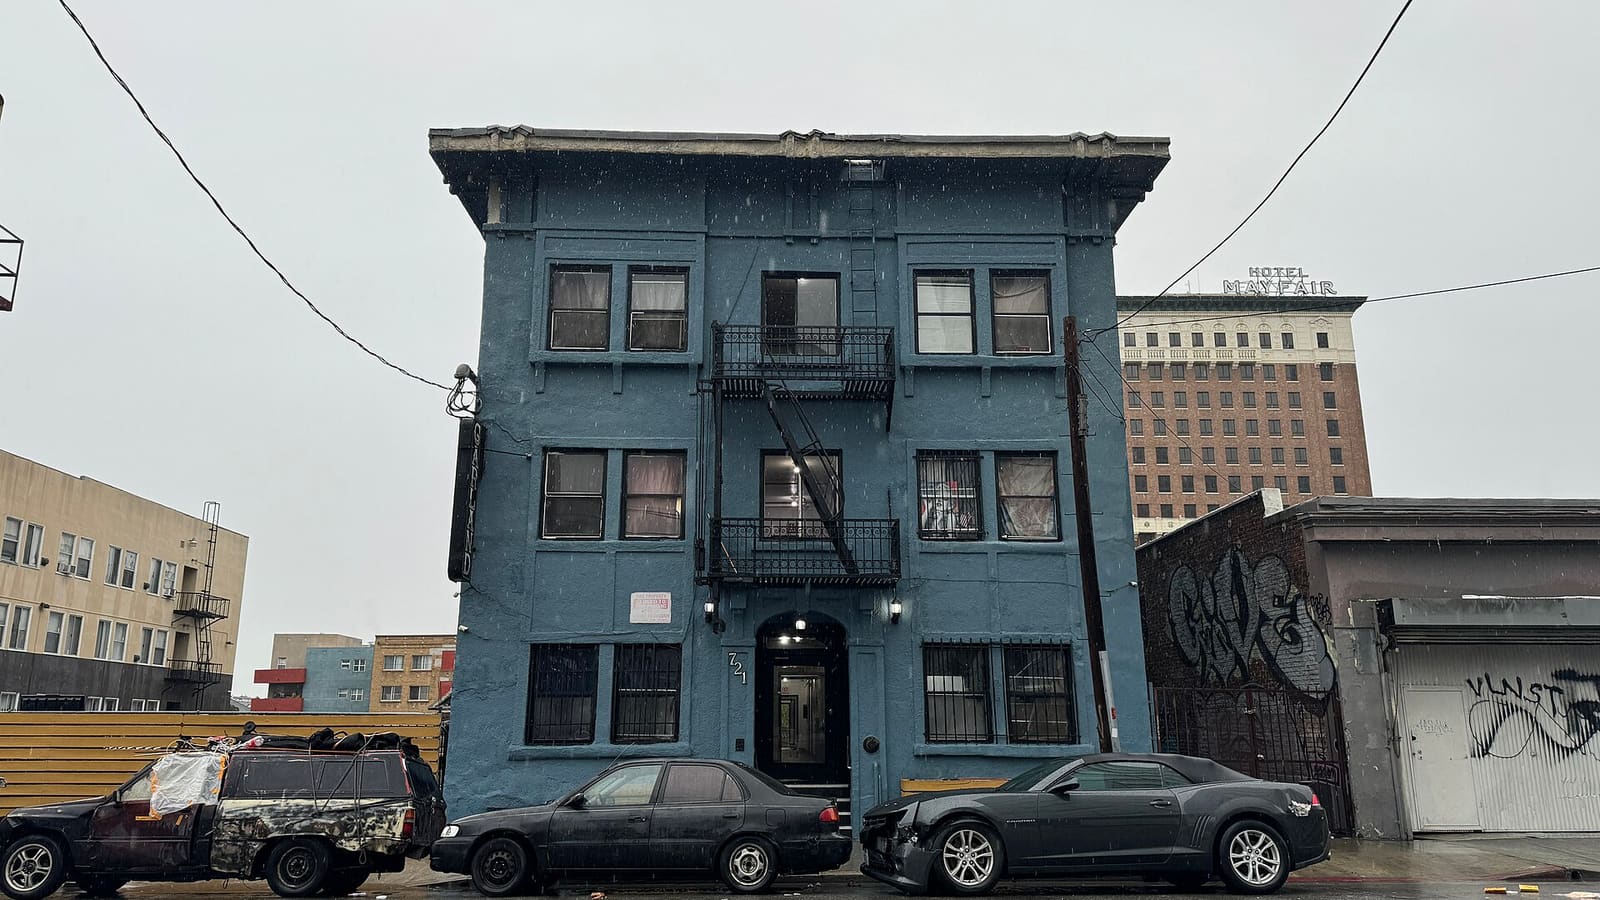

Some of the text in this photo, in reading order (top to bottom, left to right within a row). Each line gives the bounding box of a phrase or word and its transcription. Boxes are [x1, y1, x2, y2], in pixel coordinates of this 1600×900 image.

[1248, 267, 1309, 278] HOTEL
[1222, 280, 1338, 296] MAYFAIR
[463, 422, 482, 576] GARLAND
[728, 652, 747, 685] 721
